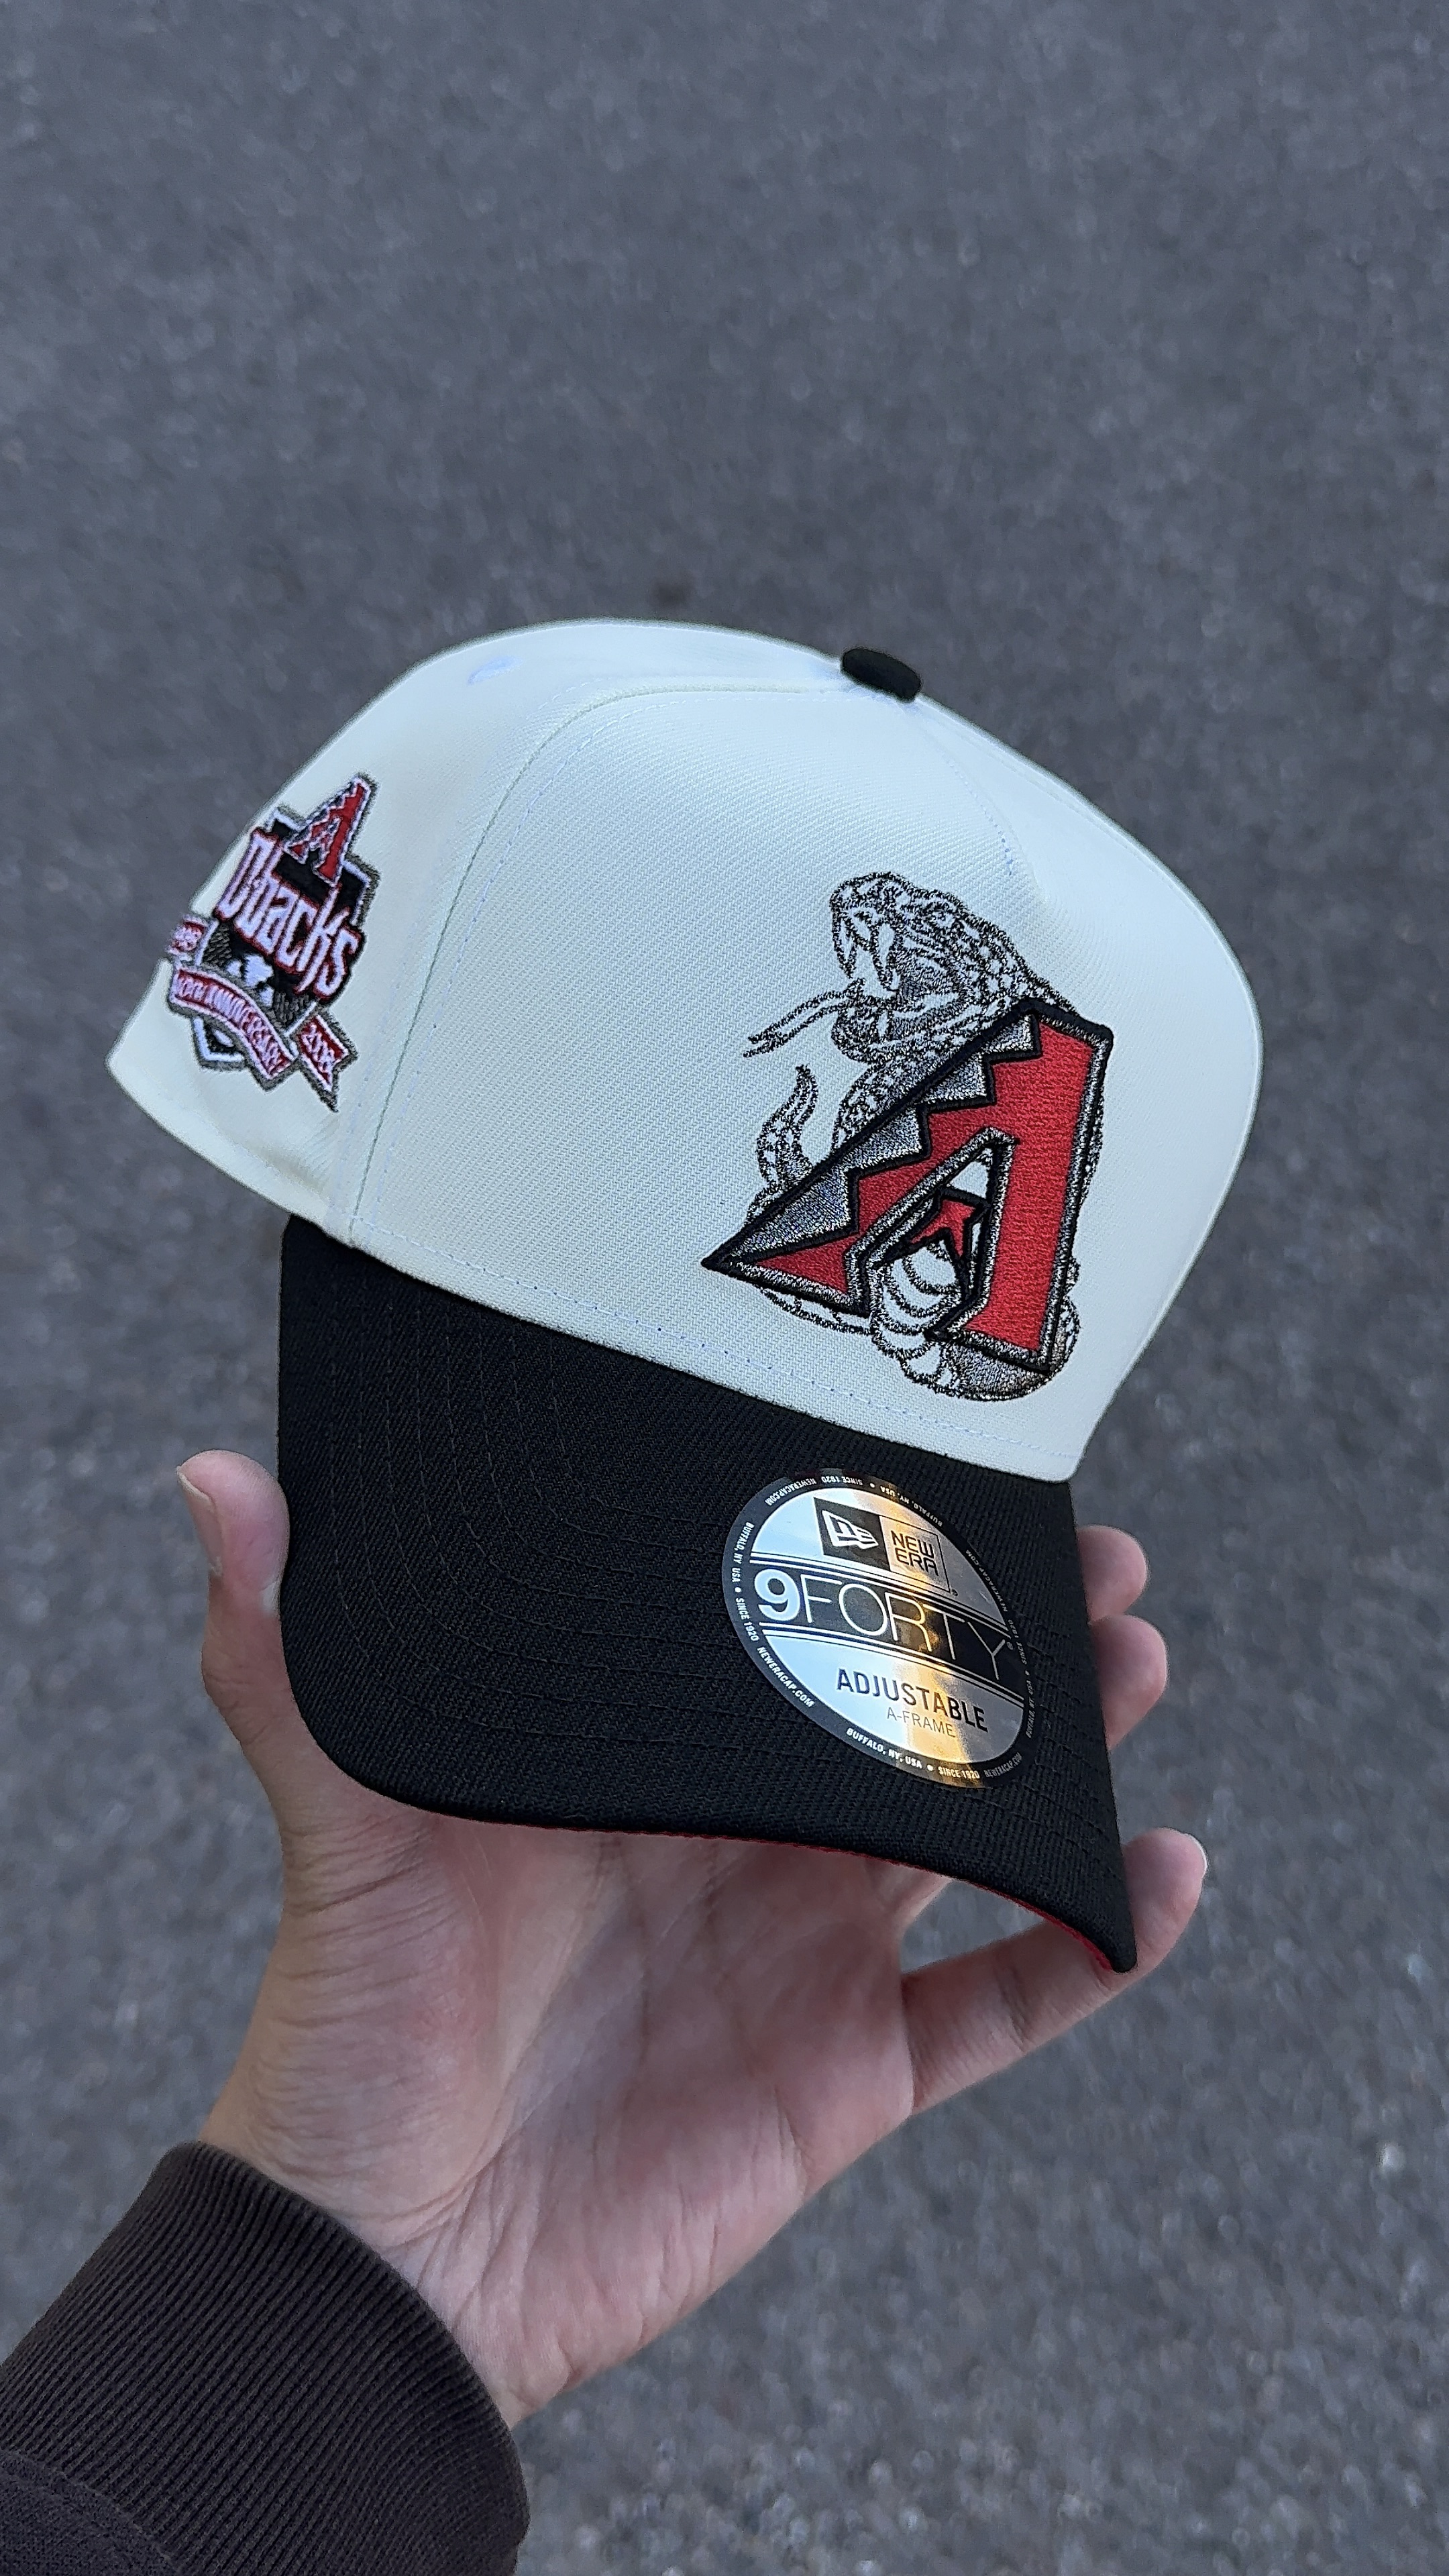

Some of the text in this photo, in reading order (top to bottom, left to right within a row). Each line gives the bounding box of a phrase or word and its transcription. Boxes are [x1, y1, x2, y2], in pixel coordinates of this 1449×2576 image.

[890, 1530, 934, 1559] NEW
[731, 1566, 741, 1582] USA
[895, 1548, 939, 1576] ERA
[735, 1597, 751, 1620] SINCE
[743, 1621, 760, 1642] 1920
[754, 1568, 1006, 1680] 9FORTY
[757, 1646, 816, 1708] NEWERACAP.COM
[836, 1668, 988, 1733] ADJUSTABLE
[886, 1707, 957, 1738] A-FRAME
[905, 1756, 922, 1769] USA
[938, 1766, 961, 1778] SINCE
[961, 1770, 980, 1779] 1920
